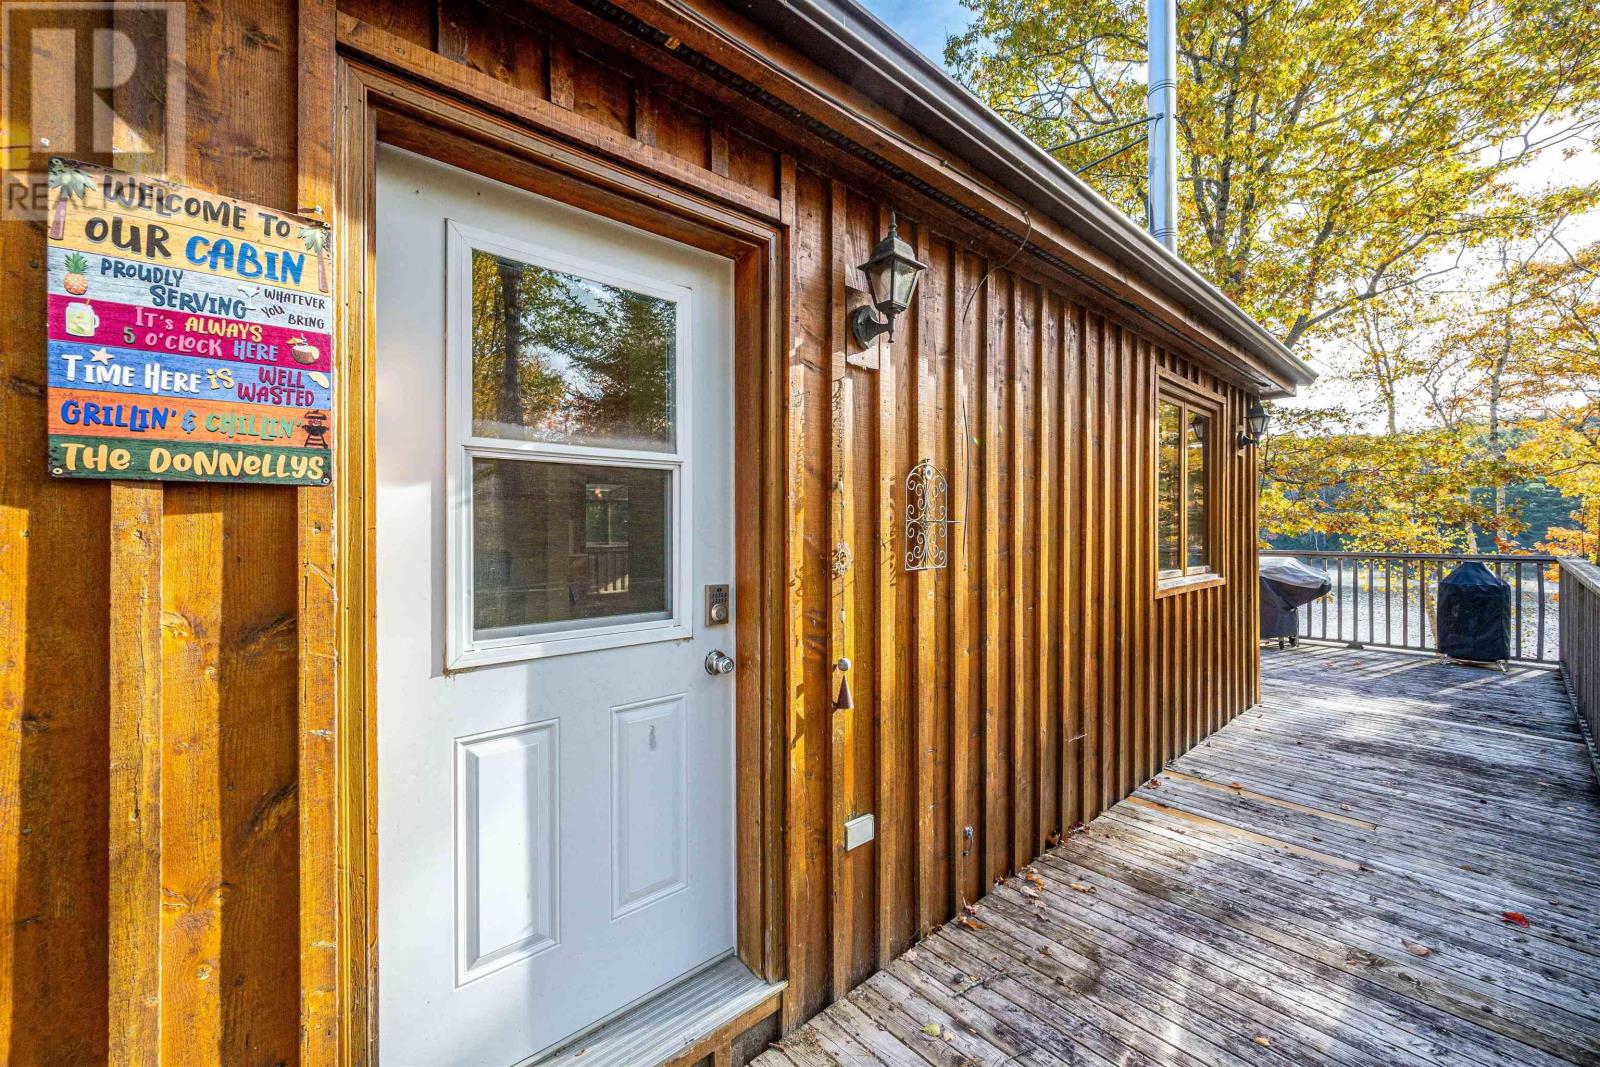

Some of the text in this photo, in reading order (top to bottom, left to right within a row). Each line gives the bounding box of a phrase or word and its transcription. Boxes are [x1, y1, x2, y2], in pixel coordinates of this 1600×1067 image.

[103, 175, 291, 238] WELCOME TO
[84, 217, 305, 286] OUR CABIN
[100, 258, 184, 288] PROUDLY
[150, 285, 246, 319] SERVING
[261, 305, 285, 318] YOU
[264, 288, 326, 310] WHATEVER
[184, 317, 263, 342] ALWAYS
[288, 314, 325, 330] BRING
[123, 327, 278, 362] 5 O'CLOCK HERE
[61, 354, 135, 387] TIME
[144, 363, 200, 394] HERE
[258, 366, 305, 389] WELL
[237, 382, 315, 407] WASTED
[60, 400, 302, 440] GRILLIN' & CHILLIN'
